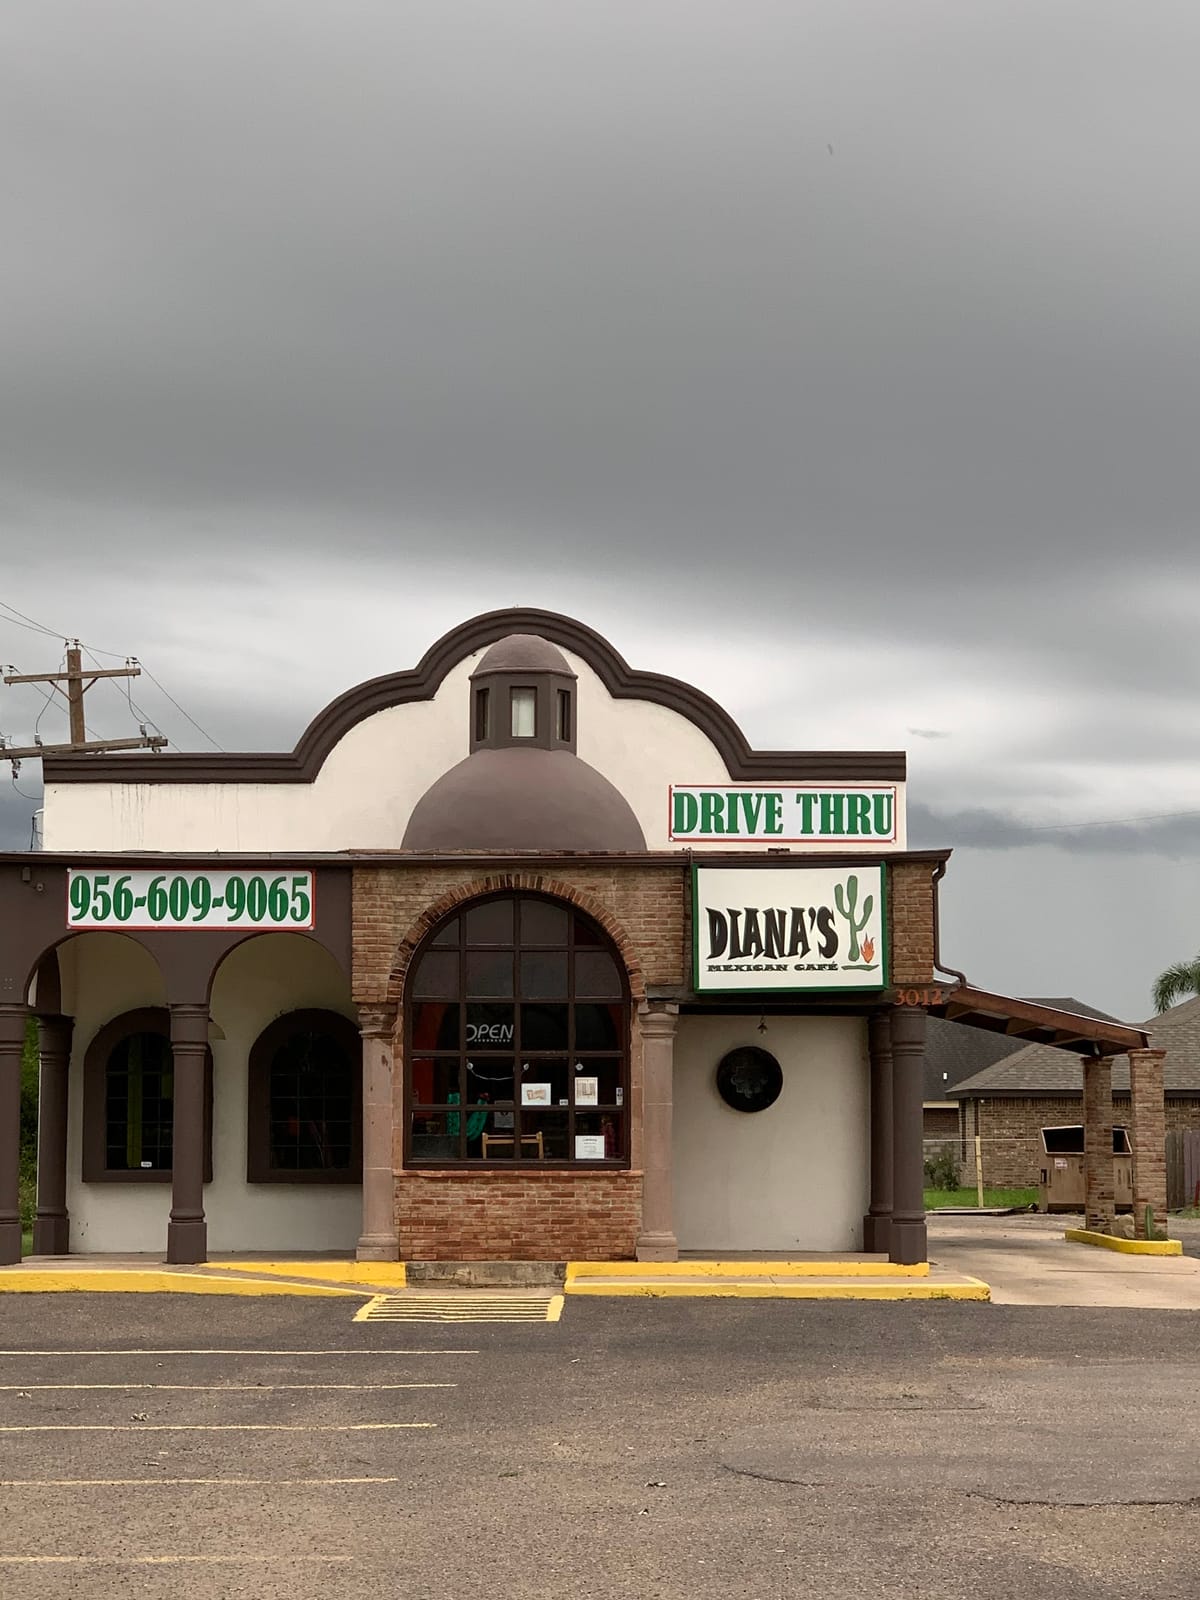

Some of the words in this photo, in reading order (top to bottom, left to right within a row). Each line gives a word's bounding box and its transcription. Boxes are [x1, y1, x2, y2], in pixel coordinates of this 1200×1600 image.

[673, 793, 783, 834] DRIVE
[796, 793, 893, 835] THRU
[70, 875, 310, 922] 956-609-9065
[705, 906, 839, 960] DIANA'S
[707, 963, 788, 972] MEXICAN
[894, 988, 943, 1007] 3012
